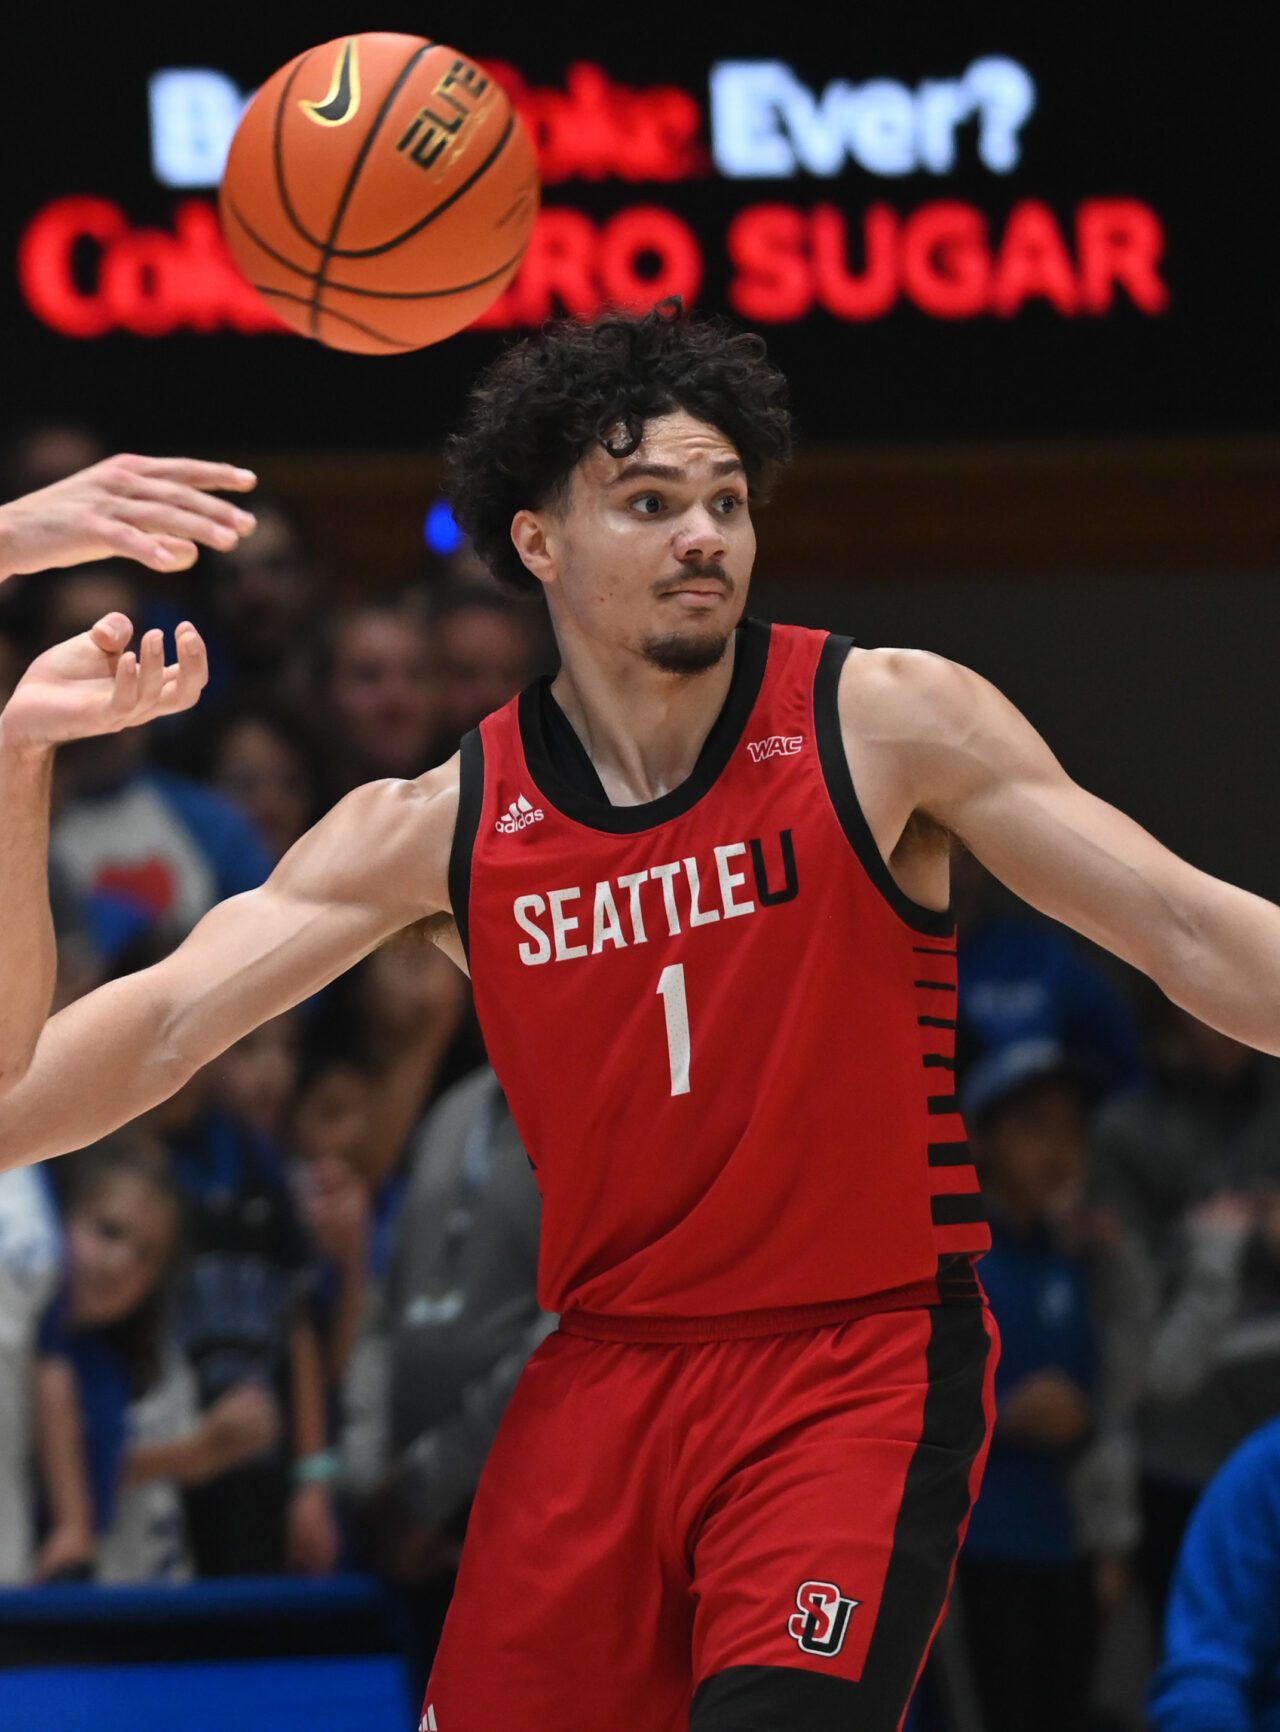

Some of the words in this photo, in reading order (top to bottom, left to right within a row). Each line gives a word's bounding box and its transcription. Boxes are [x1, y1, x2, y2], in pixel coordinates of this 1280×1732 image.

[395, 58, 490, 172] ELITE
[476, 60, 706, 184] oke
[710, 55, 1037, 178] Ever?
[472, 203, 703, 330] RO
[728, 196, 1169, 322] SUGAR
[747, 735, 803, 763] WAC
[495, 808, 545, 834] adidas
[656, 962, 691, 1096] 1
